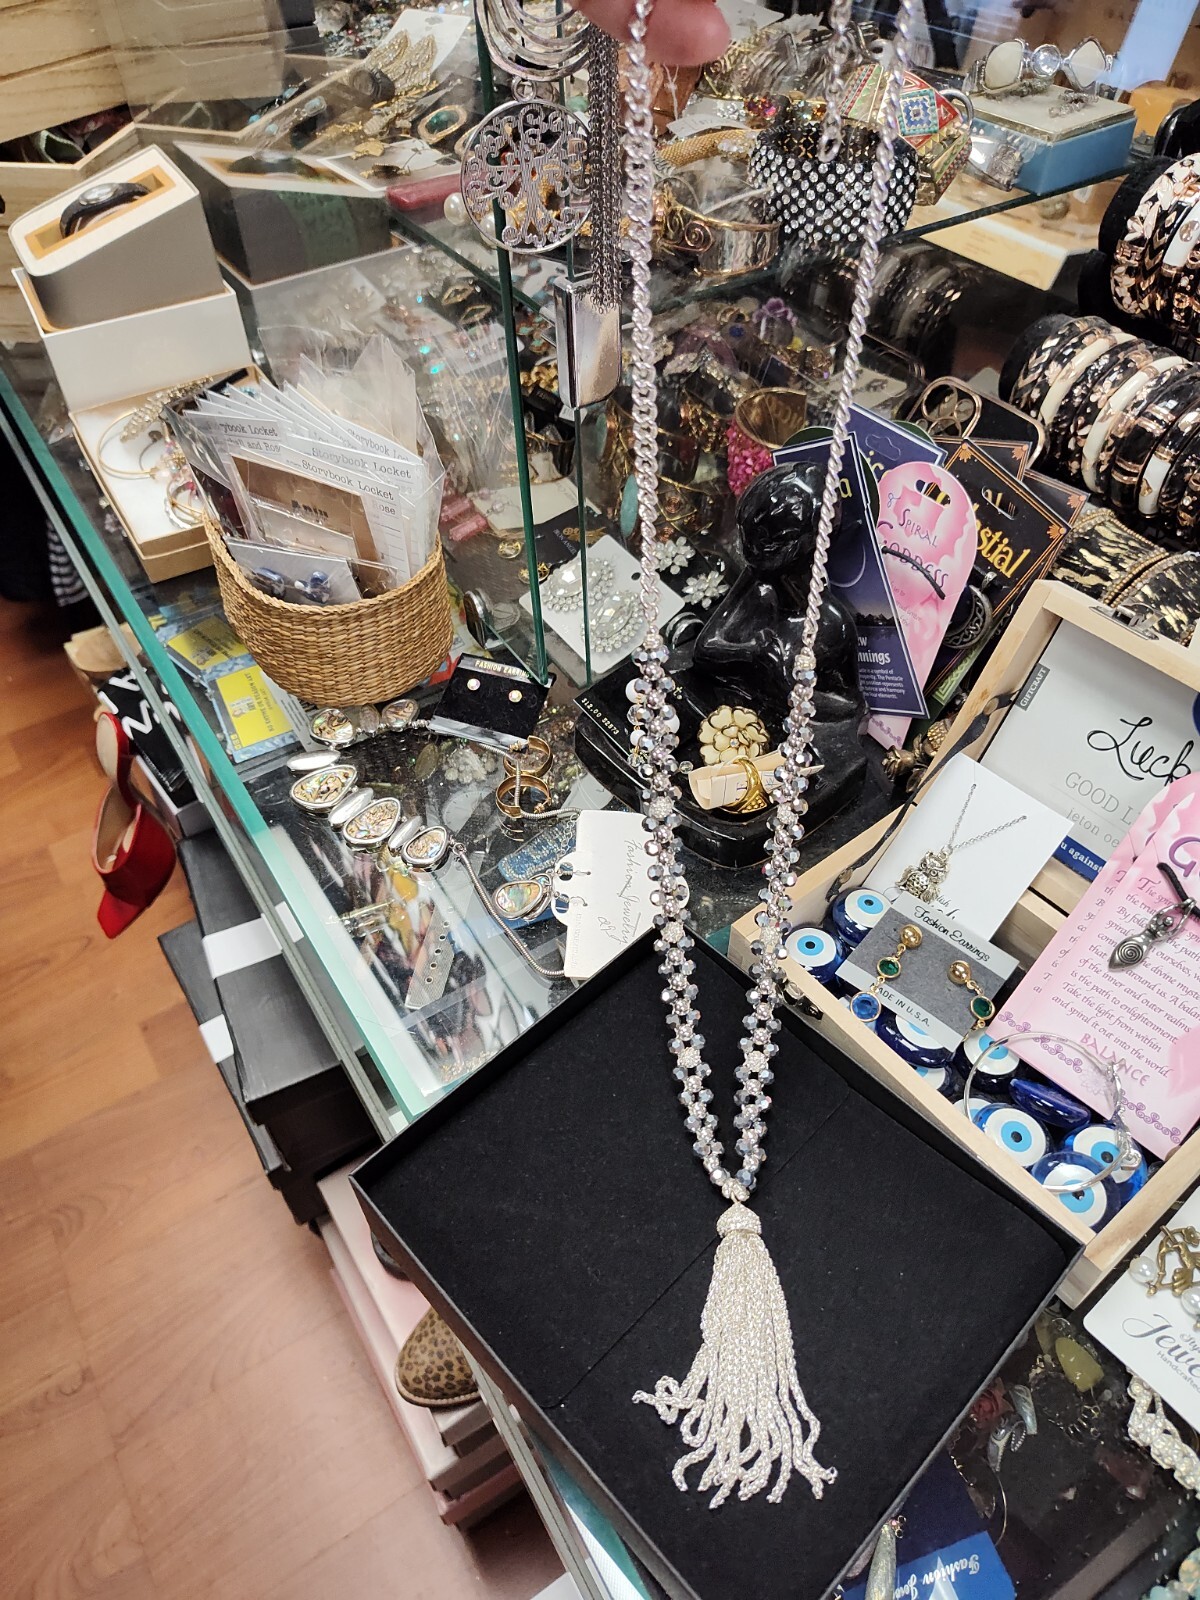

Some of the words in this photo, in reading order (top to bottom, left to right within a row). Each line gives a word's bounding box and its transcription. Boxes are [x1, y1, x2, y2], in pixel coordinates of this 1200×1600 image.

[247, 425, 277, 439] Locket
[301, 460, 355, 486] Storybook
[358, 481, 393, 500] Locket
[312, 448, 366, 470] Storybook
[374, 462, 410, 478] Locket
[475, 659, 501, 672] FASHION
[1019, 667, 1046, 706] GIFTCRAFT
[1067, 773, 1118, 812] GOOD
[1067, 808, 1099, 835] jeton
[1068, 846, 1102, 872] against
[1125, 892, 1139, 905] the
[1138, 875, 1161, 896] The
[915, 906, 948, 934] Fashion
[950, 930, 989, 961] Earrings
[1105, 919, 1130, 940] spiral
[1156, 946, 1190, 976] ourselves,
[1116, 906, 1130, 920] By
[1178, 947, 1200, 962] path
[1078, 956, 1090, 968] of
[1088, 960, 1102, 974] the
[1102, 972, 1122, 987] inner
[1124, 985, 1143, 1000] and
[1141, 999, 1164, 1013] outer
[1164, 1013, 1190, 1032] realms
[1089, 944, 1107, 958] that
[1126, 966, 1156, 990] around
[1156, 988, 1167, 999] us.
[1169, 994, 1179, 1005] A
[1151, 965, 1175, 984] divine
[895, 999, 905, 1008] IN
[906, 1006, 929, 1026] U.S.A.
[1063, 982, 1081, 998] Take
[1081, 995, 1095, 1007] the
[1095, 1003, 1114, 1021] light
[1109, 1016, 1134, 1034] from
[1135, 1032, 1161, 1052] within
[1070, 970, 1077, 978] is
[1078, 974, 1091, 986] the
[1086, 982, 1110, 1000] path
[1110, 995, 1120, 1006] to
[1121, 1005, 1177, 1044] enlightenment.
[1052, 995, 1070, 1009] and
[1067, 1007, 1092, 1024] spiral
[1091, 1020, 1099, 1029] it
[1098, 1027, 1113, 1039] out
[1113, 1036, 1130, 1050] into
[1130, 1046, 1144, 1060] the
[1145, 1058, 1173, 1077] world.
[1079, 1035, 1147, 1085] BALANCE
[923, 1554, 980, 1585] Fashion
